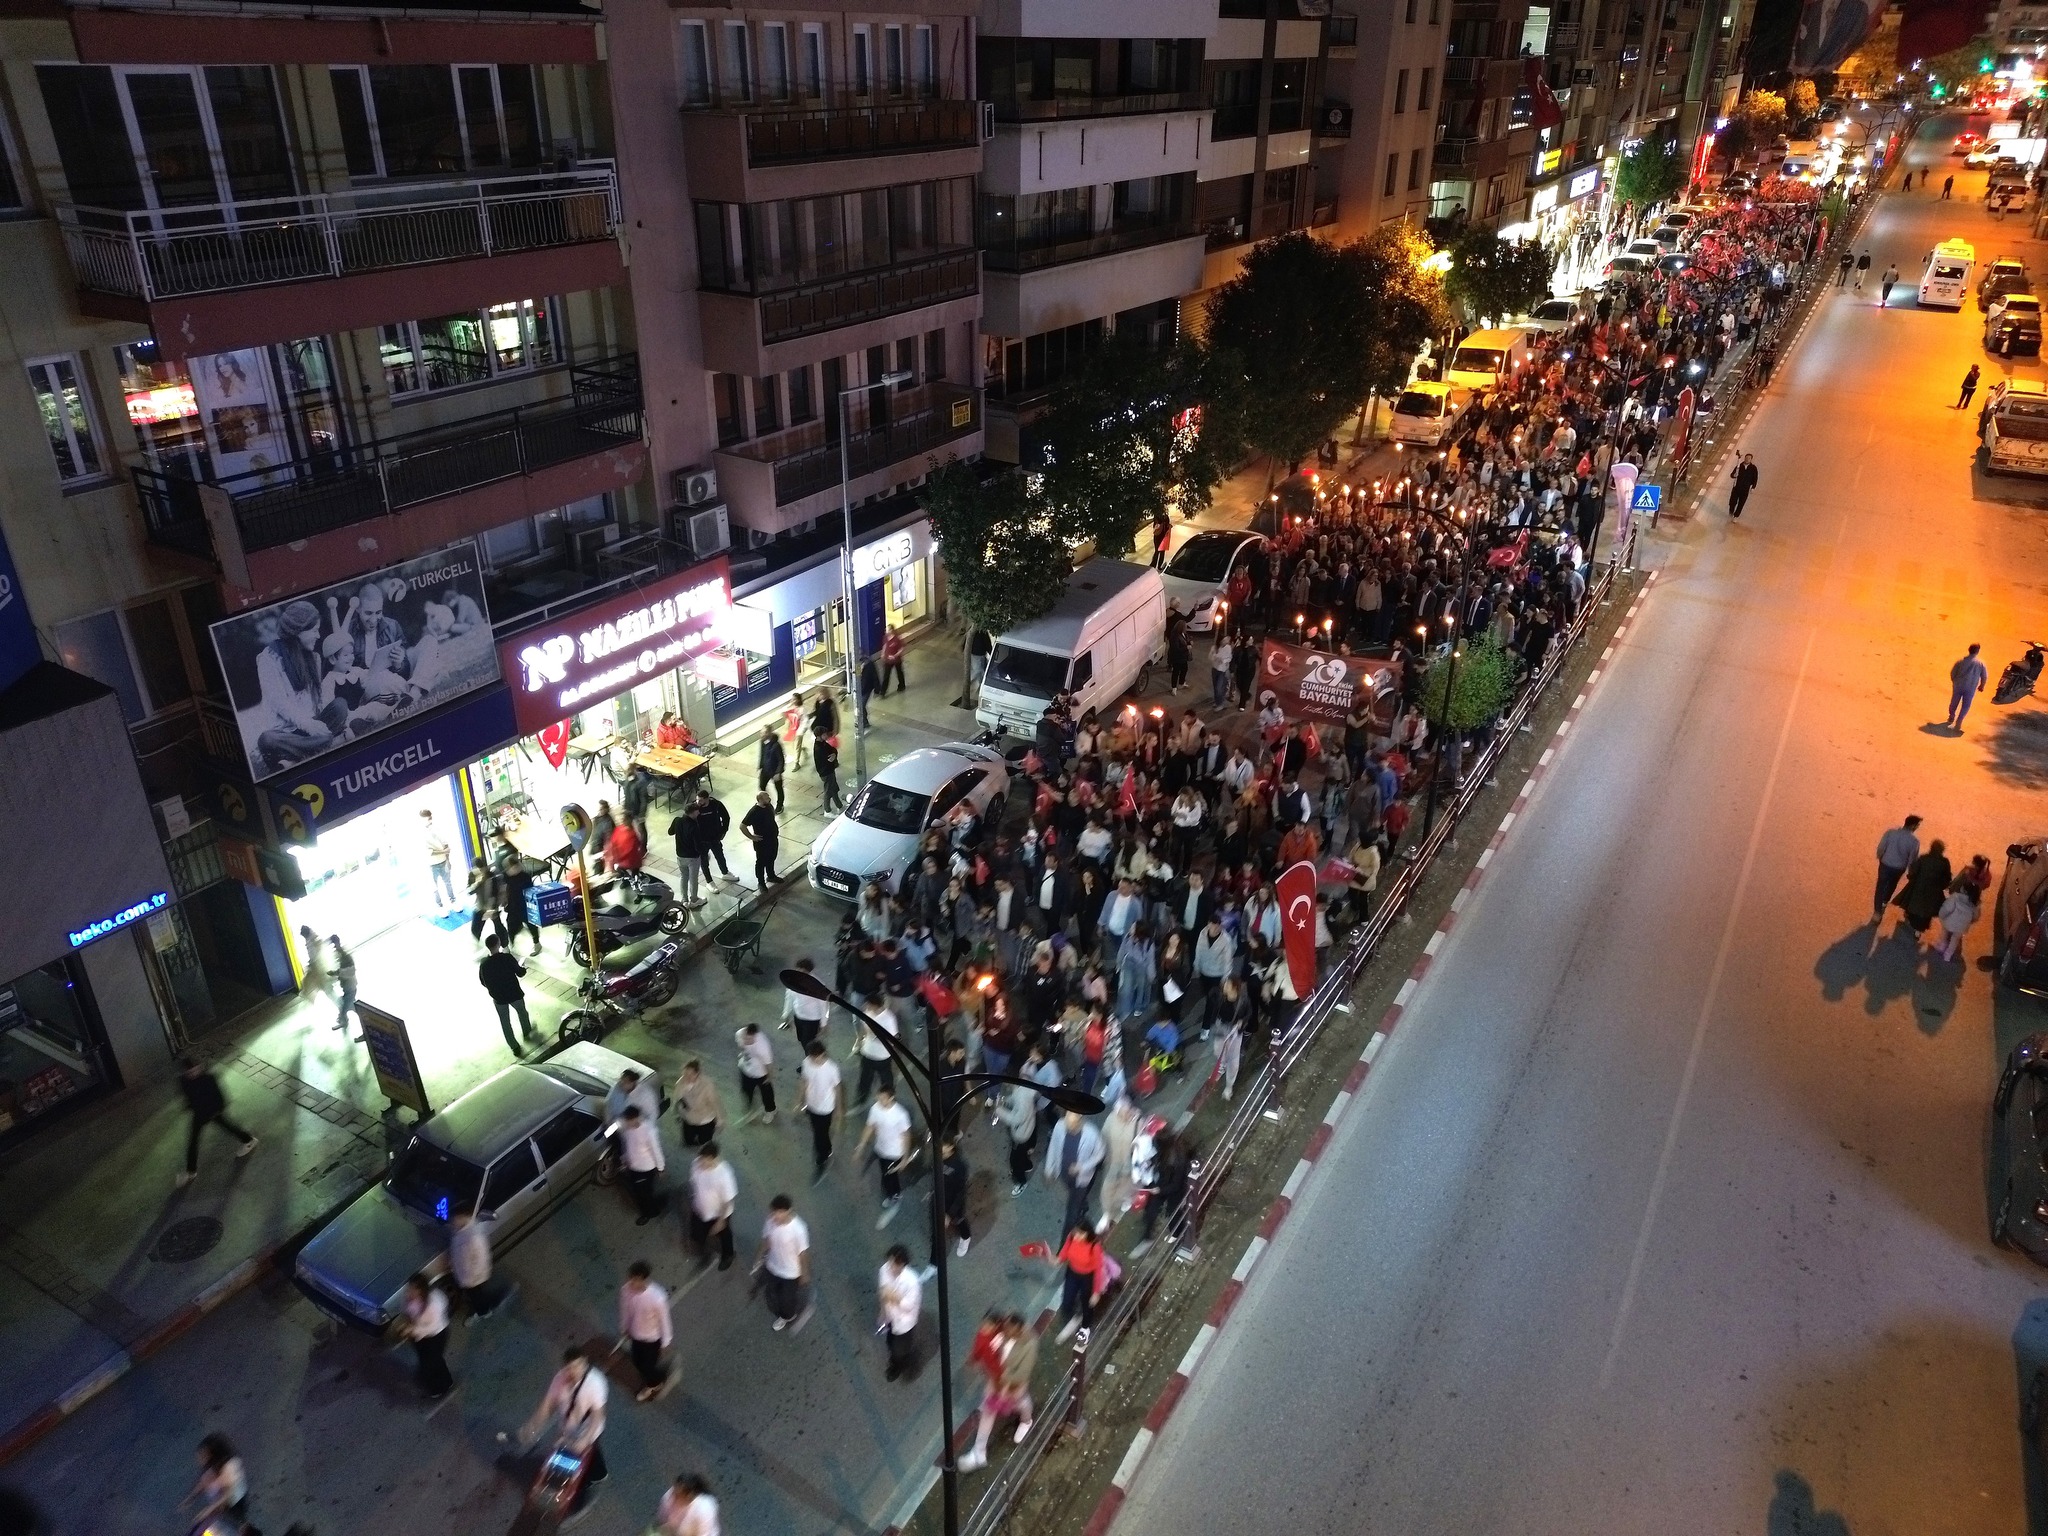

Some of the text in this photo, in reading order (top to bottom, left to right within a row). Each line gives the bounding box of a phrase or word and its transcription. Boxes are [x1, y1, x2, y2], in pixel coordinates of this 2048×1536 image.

[409, 561, 473, 591] TURKCELL
[1300, 689, 1351, 708] BAYRAMI
[1301, 682, 1353, 698] CUMHURİYET
[330, 739, 441, 799] TURKCELL
[69, 892, 166, 947] beko.com.tr
